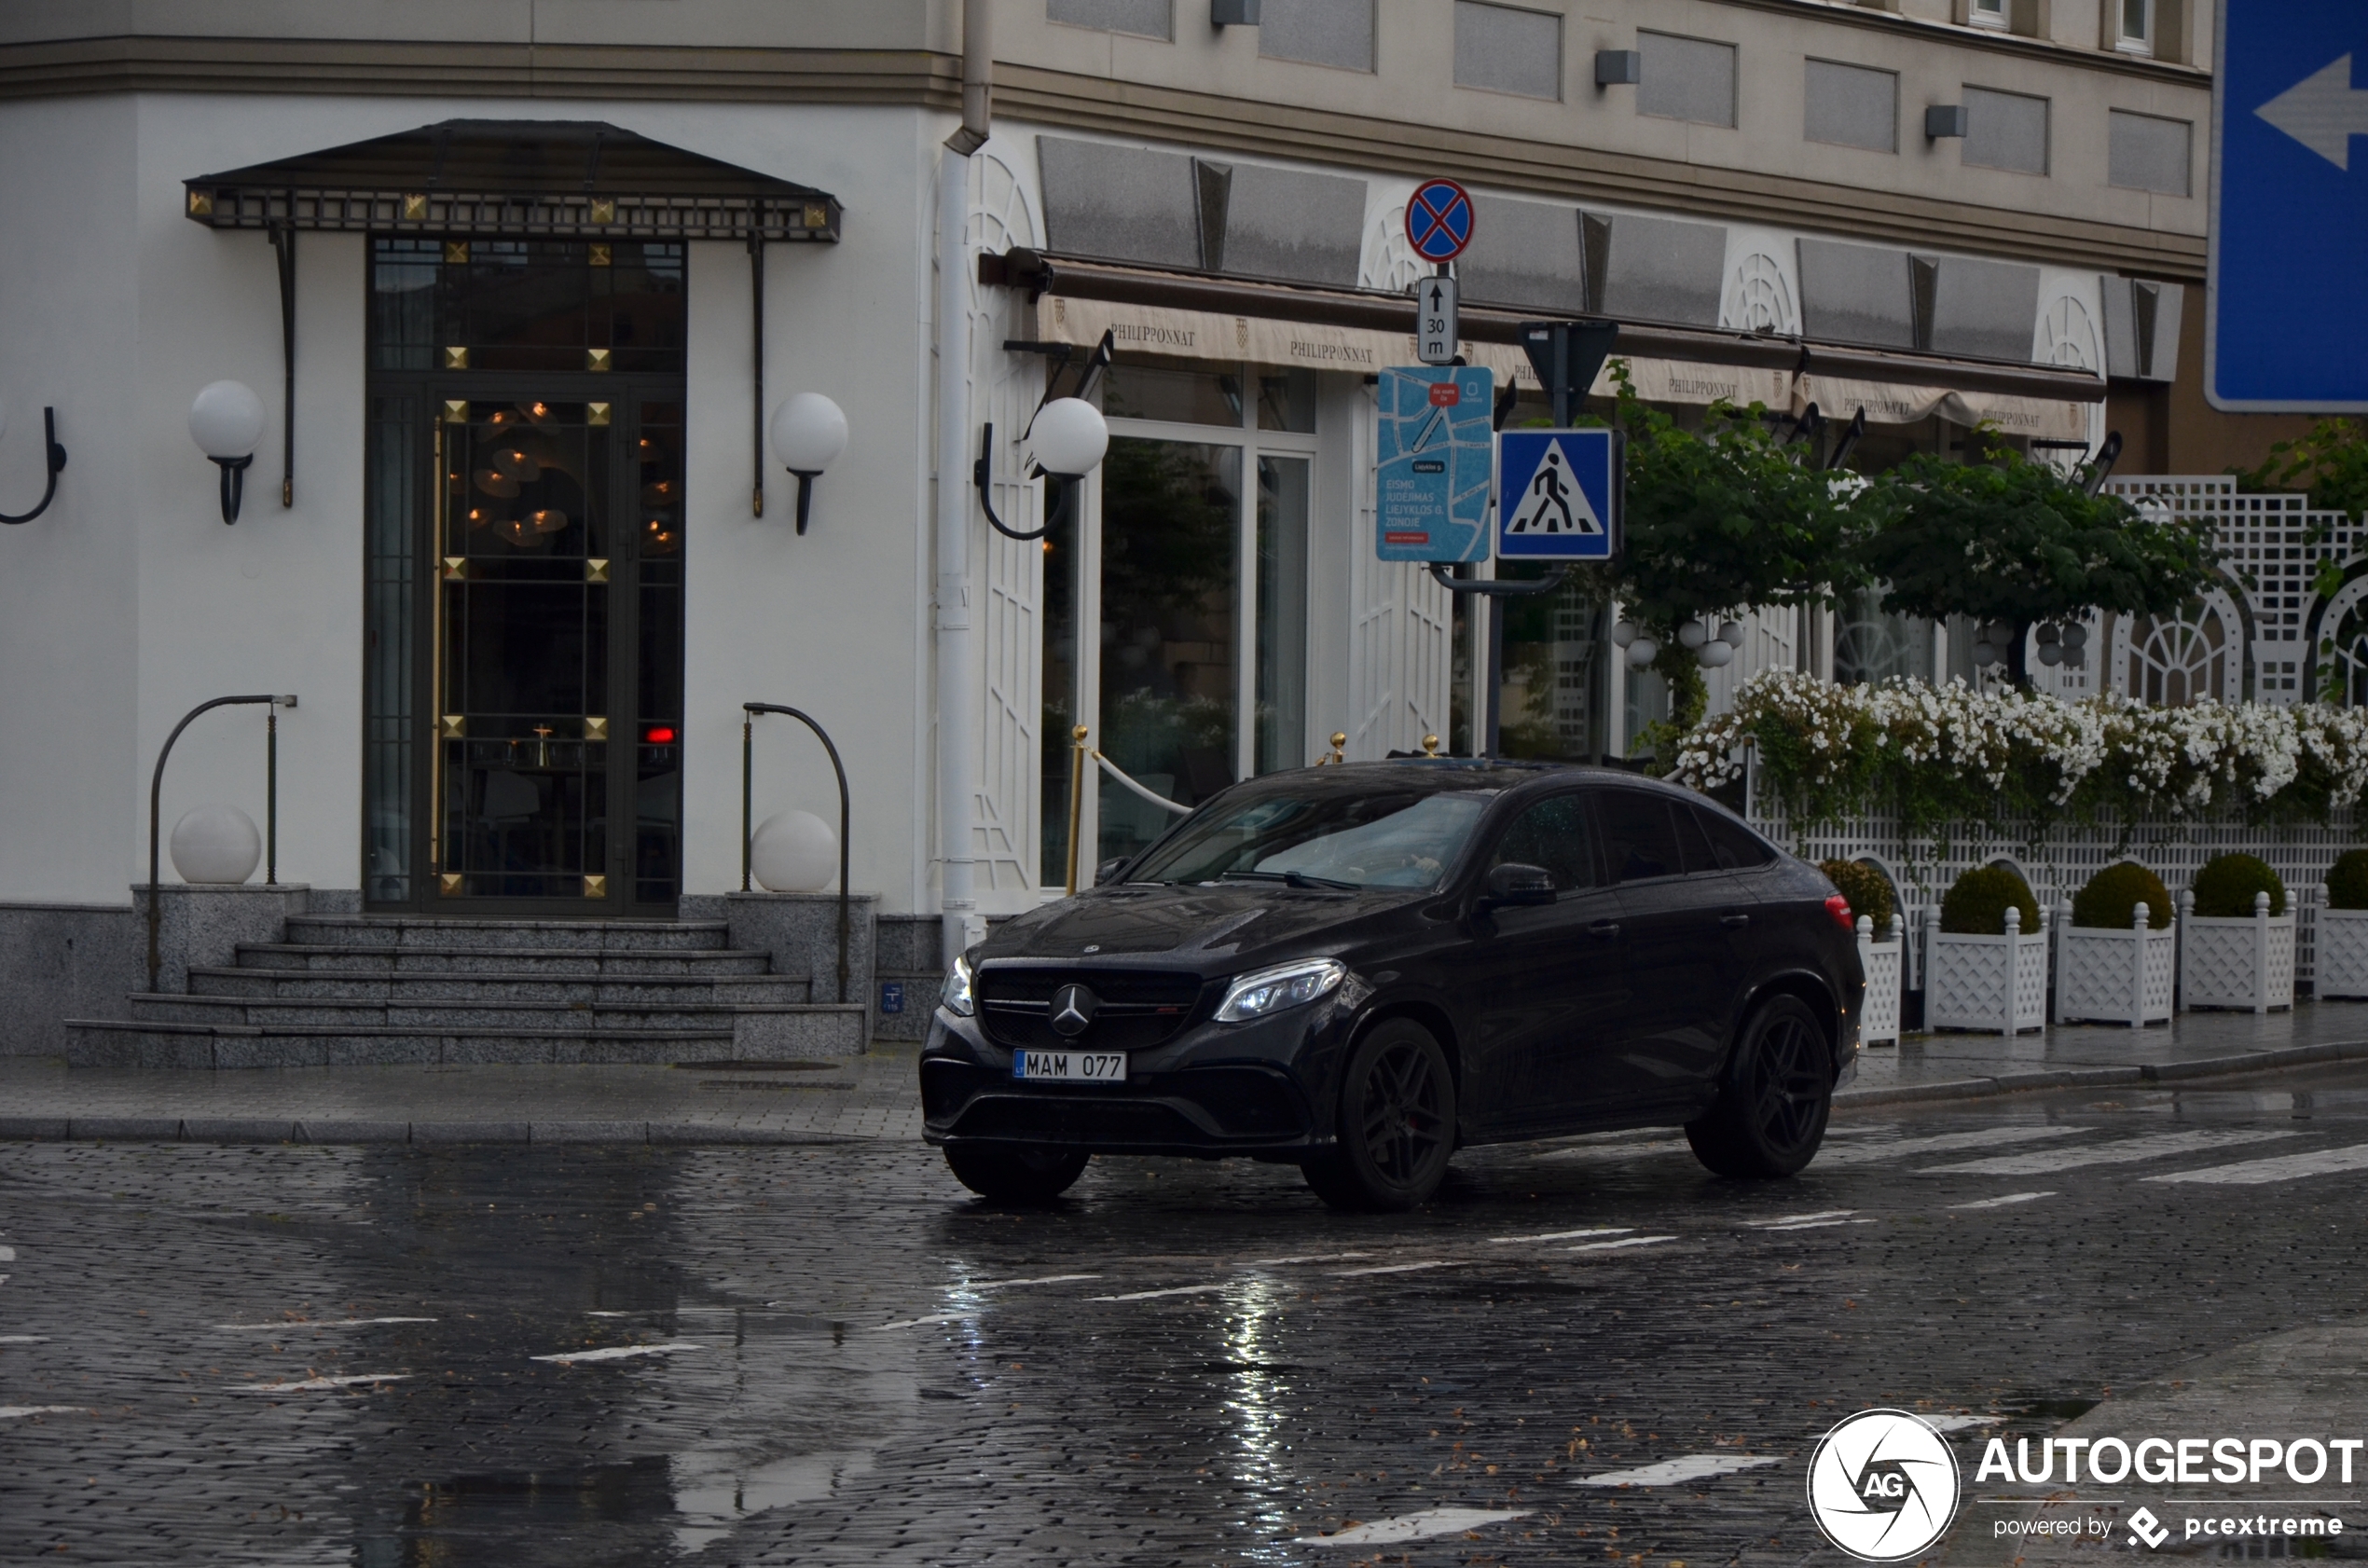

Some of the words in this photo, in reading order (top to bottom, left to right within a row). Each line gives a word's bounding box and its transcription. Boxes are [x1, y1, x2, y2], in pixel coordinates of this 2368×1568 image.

[1427, 319, 1445, 334] 30
[1111, 323, 1195, 346] PHILIPPONNAT
[1290, 341, 1372, 364] PHILIPPONNAT
[1428, 341, 1443, 354] m
[1669, 378, 1738, 397] PHILIPPONNAT
[1386, 480, 1414, 489] EISMO
[1386, 490, 1434, 502] JUDĖJIMAS
[1386, 505, 1432, 515] LIEJYKLOS
[1435, 505, 1444, 515] G.
[1385, 517, 1420, 527] ZONOJE
[1026, 1053, 1067, 1076] MAM
[1082, 1055, 1122, 1077] 077
